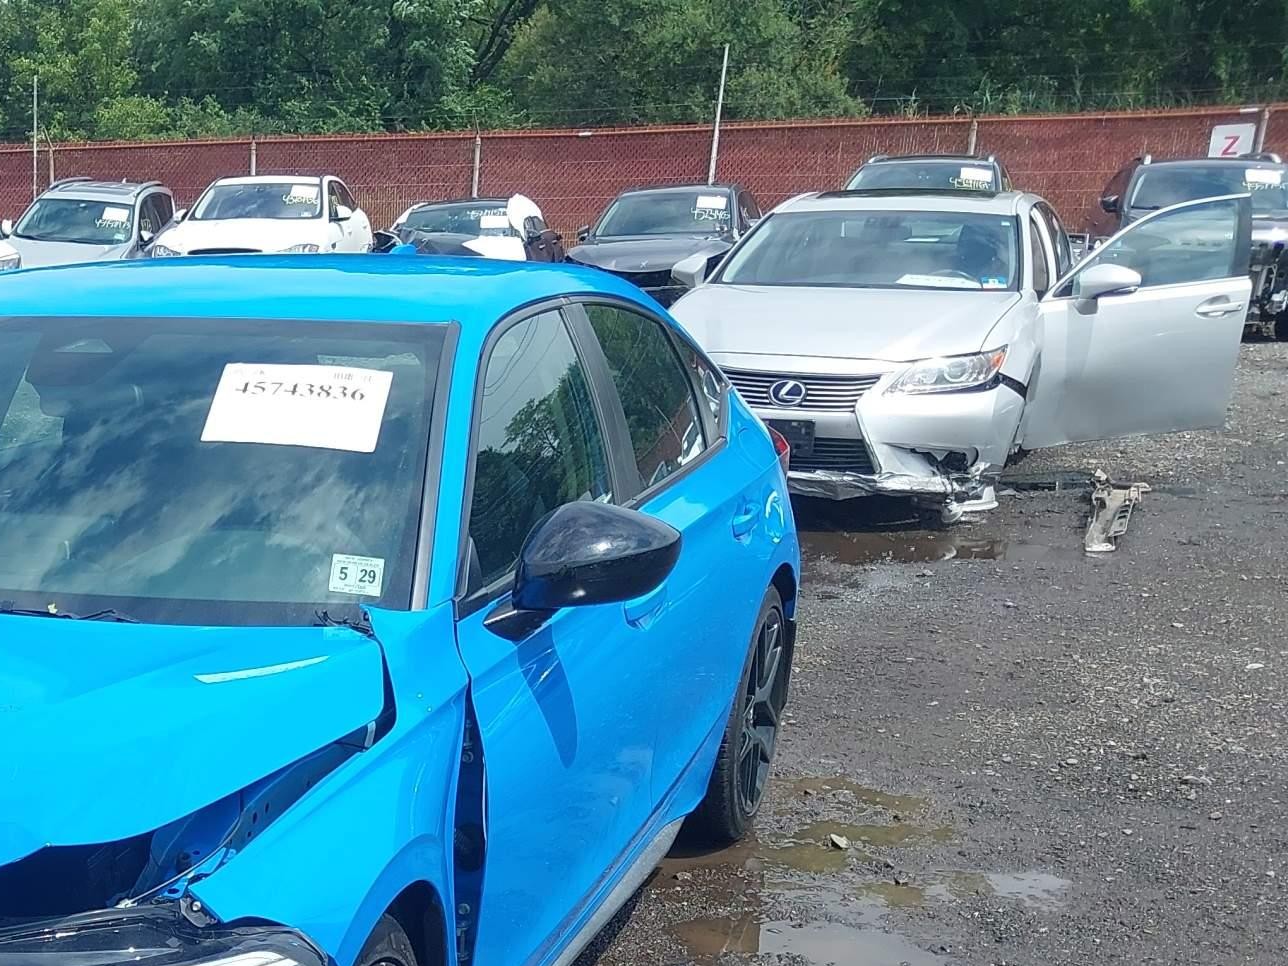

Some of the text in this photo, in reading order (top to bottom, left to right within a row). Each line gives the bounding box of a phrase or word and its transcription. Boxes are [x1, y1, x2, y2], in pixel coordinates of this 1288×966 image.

[1221, 135, 1241, 156] Z
[235, 380, 366, 402] 45743836
[339, 566, 377, 584] 5 29
